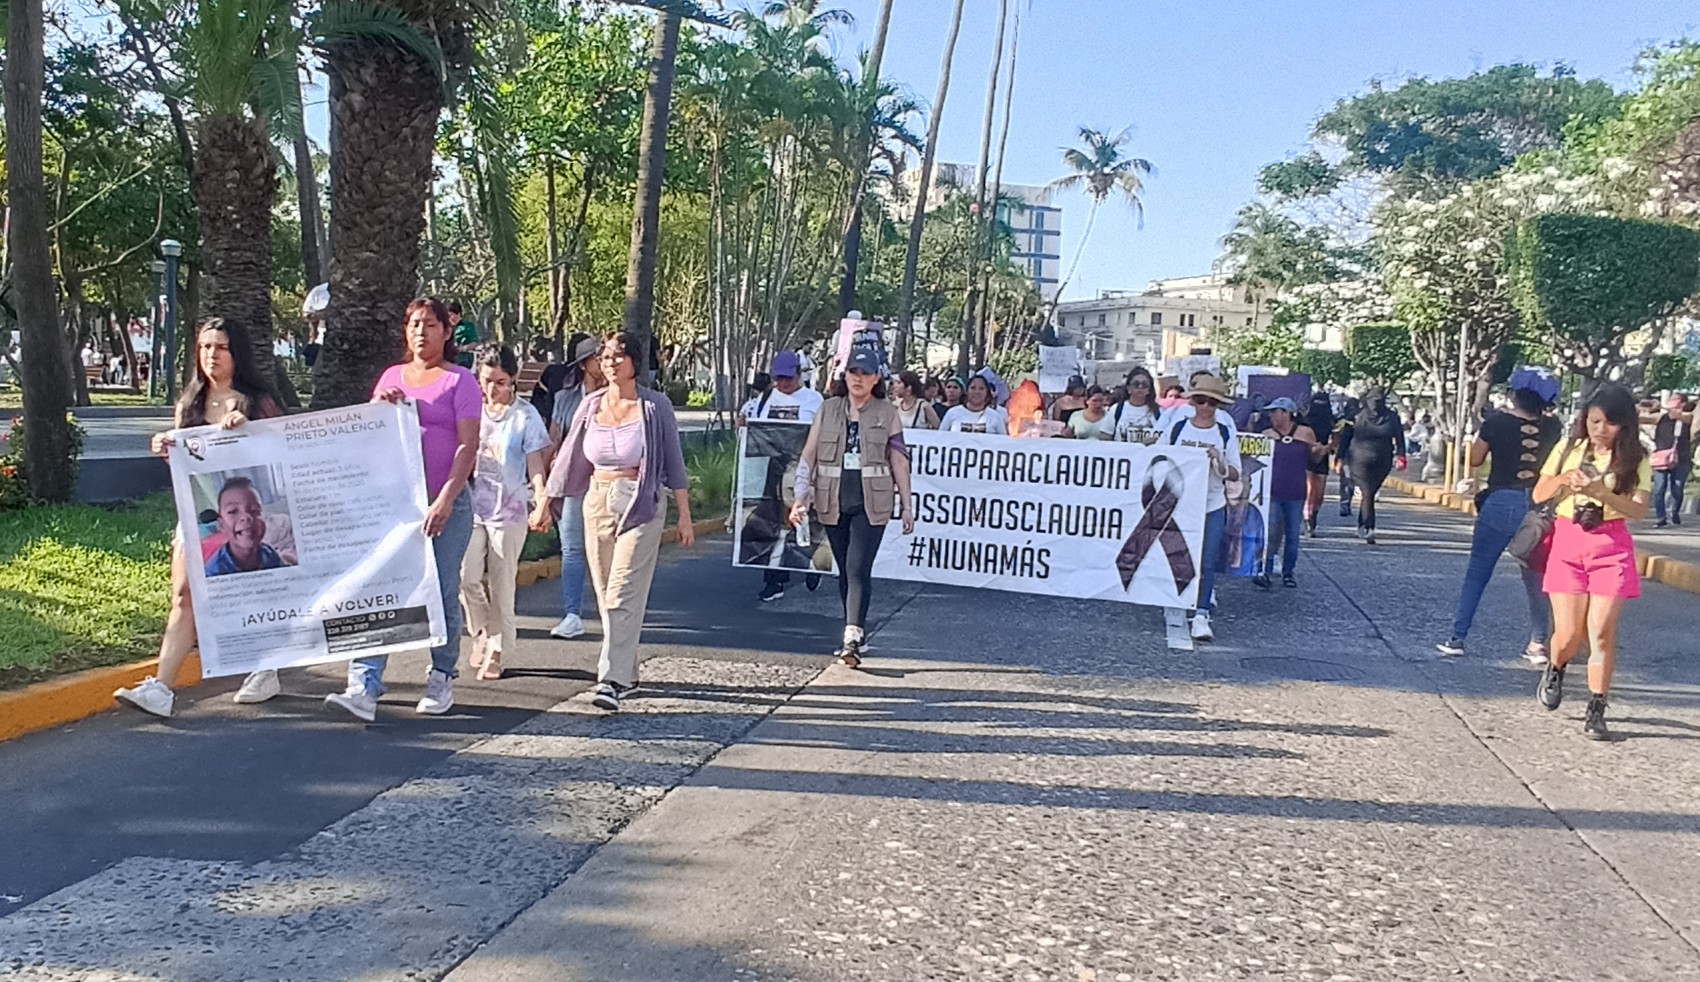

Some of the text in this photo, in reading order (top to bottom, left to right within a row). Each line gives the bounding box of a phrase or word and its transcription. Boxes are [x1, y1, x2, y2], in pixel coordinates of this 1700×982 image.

[286, 420, 386, 442] PRIETO VALENCIA
[908, 537, 1051, 579] #NIUNAMÁS
